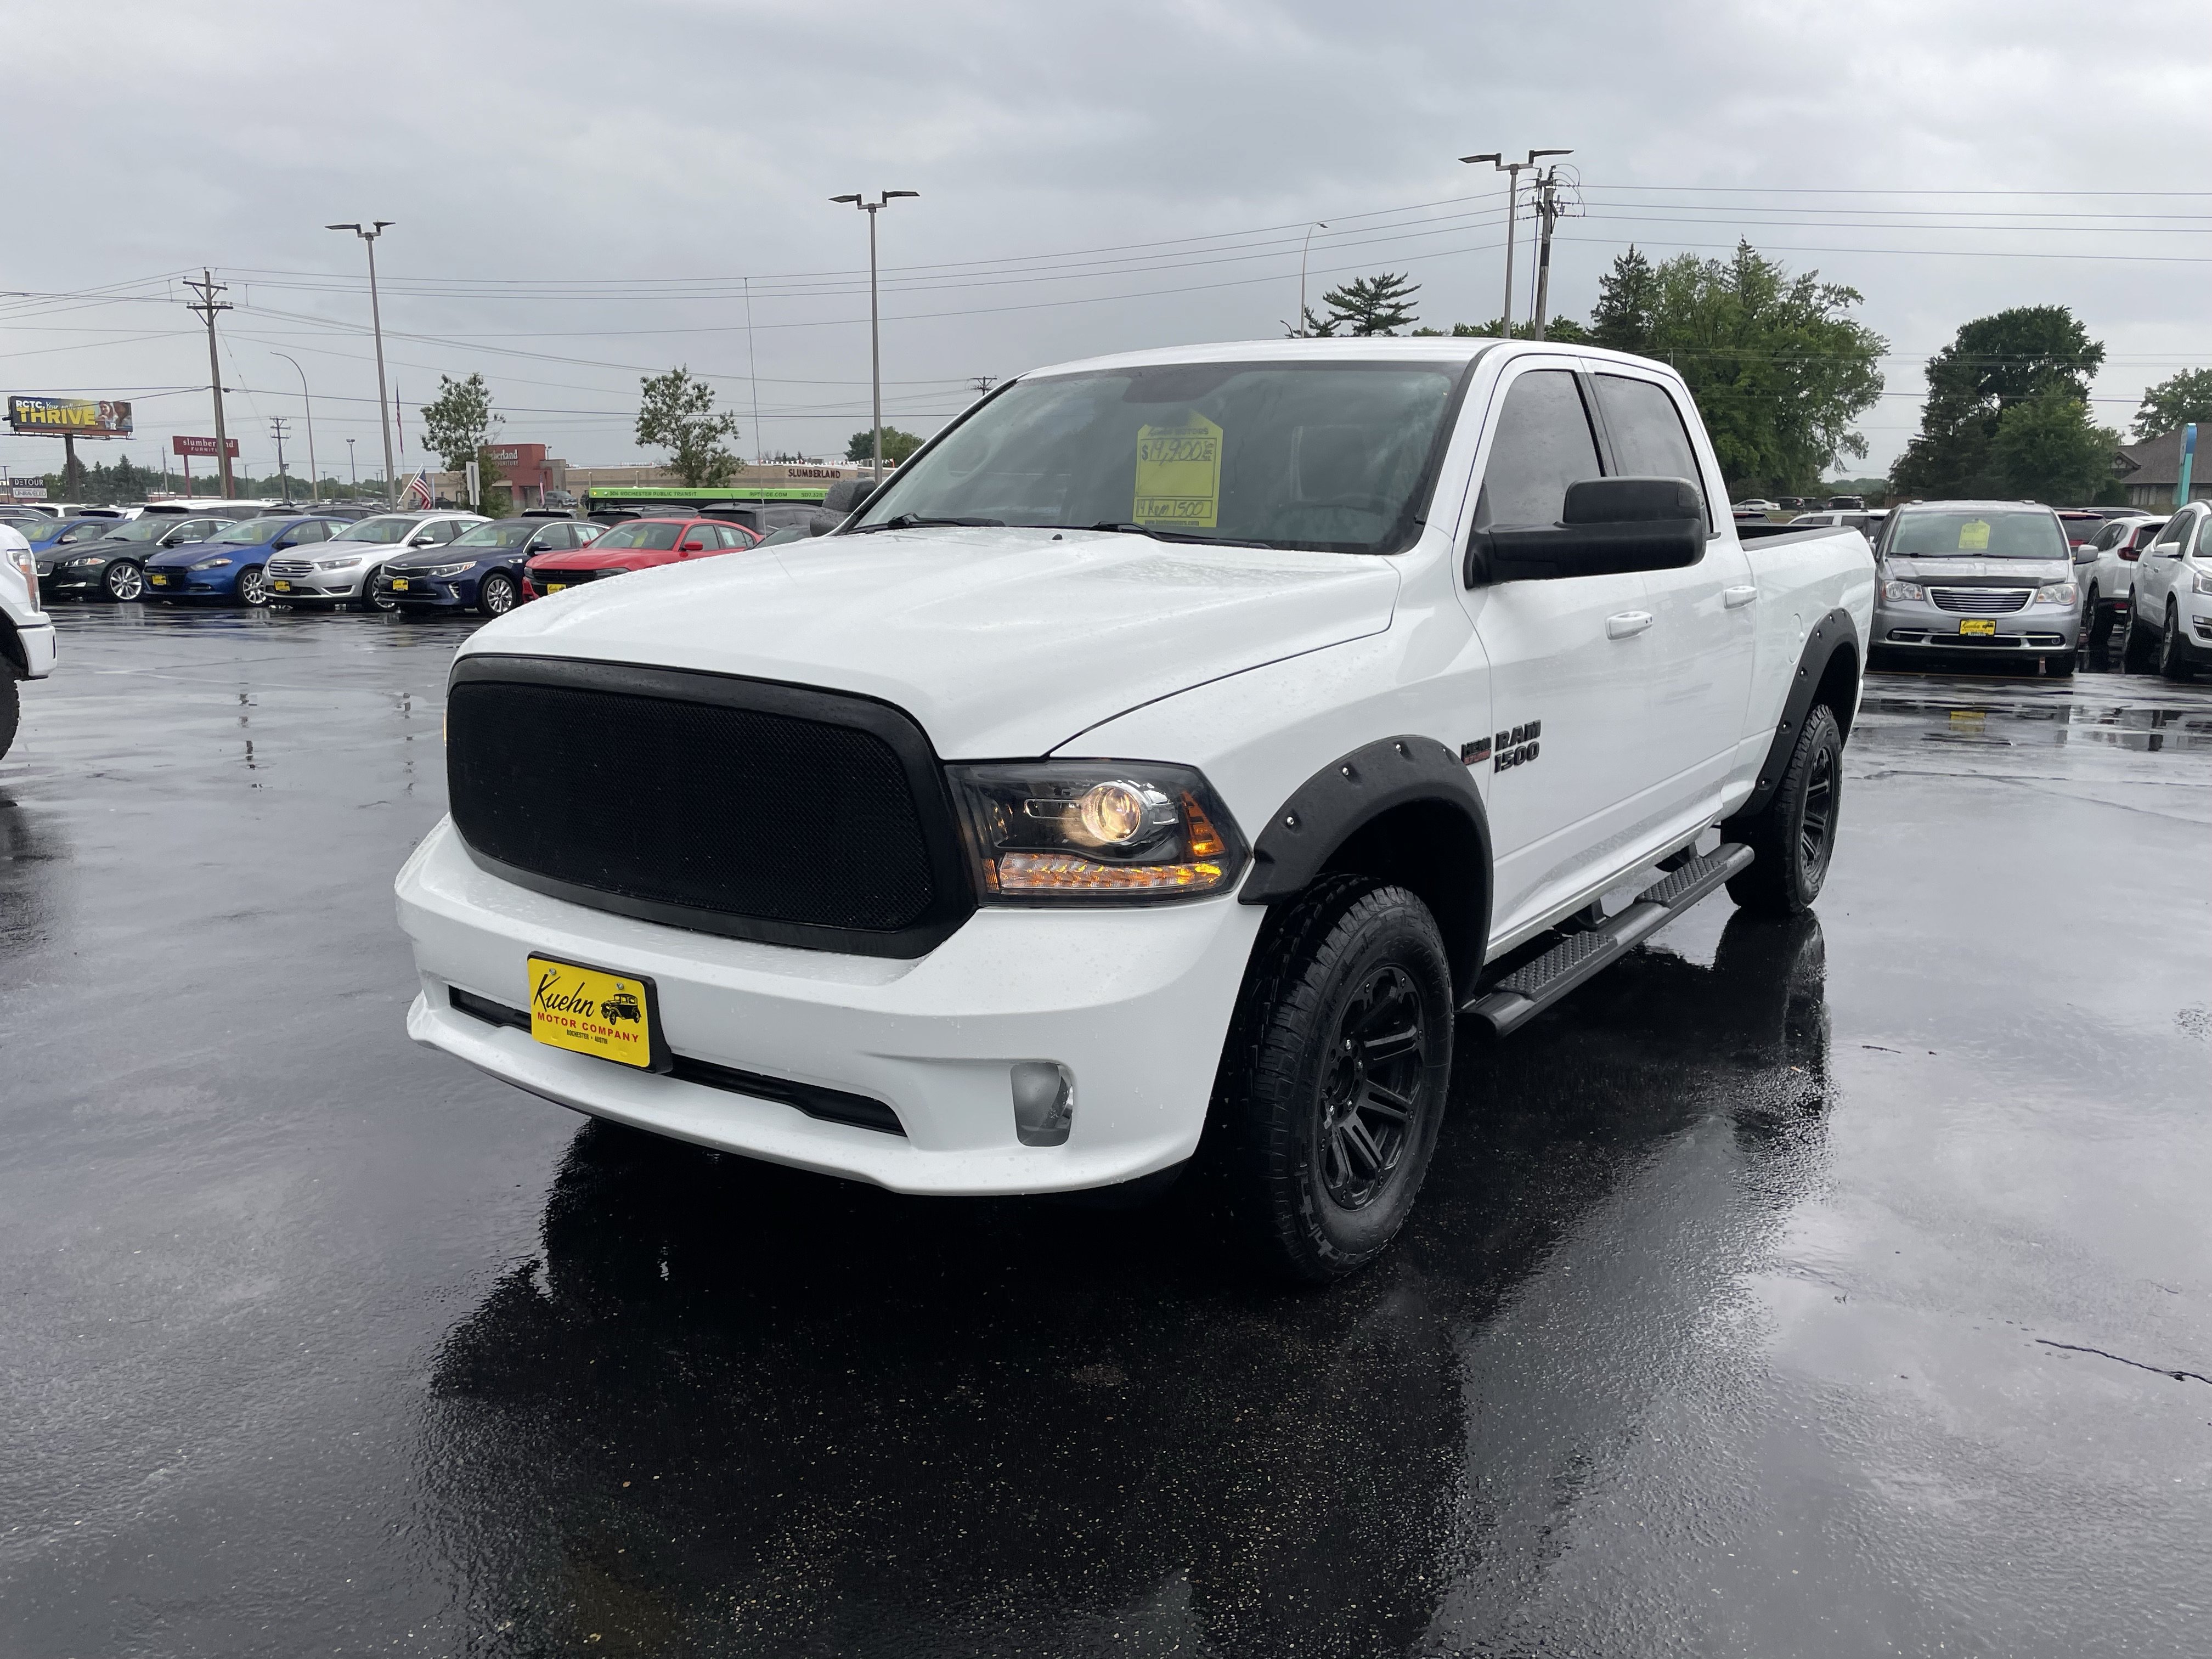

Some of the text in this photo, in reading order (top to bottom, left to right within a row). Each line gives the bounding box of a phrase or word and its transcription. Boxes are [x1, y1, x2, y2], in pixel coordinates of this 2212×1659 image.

[16, 400, 46, 409] RCTC.
[16, 407, 98, 425] THRIVE.
[183, 438, 234, 448] slumbernd
[788, 469, 840, 478] SLUMBERLAND
[1172, 500, 1204, 517] 1500
[1495, 719, 1542, 752] RAM
[1494, 741, 1540, 774] 1500
[533, 973, 595, 1018] Kuehn
[537, 1012, 640, 1043] MOTOR COMPANY
[566, 1029, 608, 1045] ROCHESTER AUSTIN
